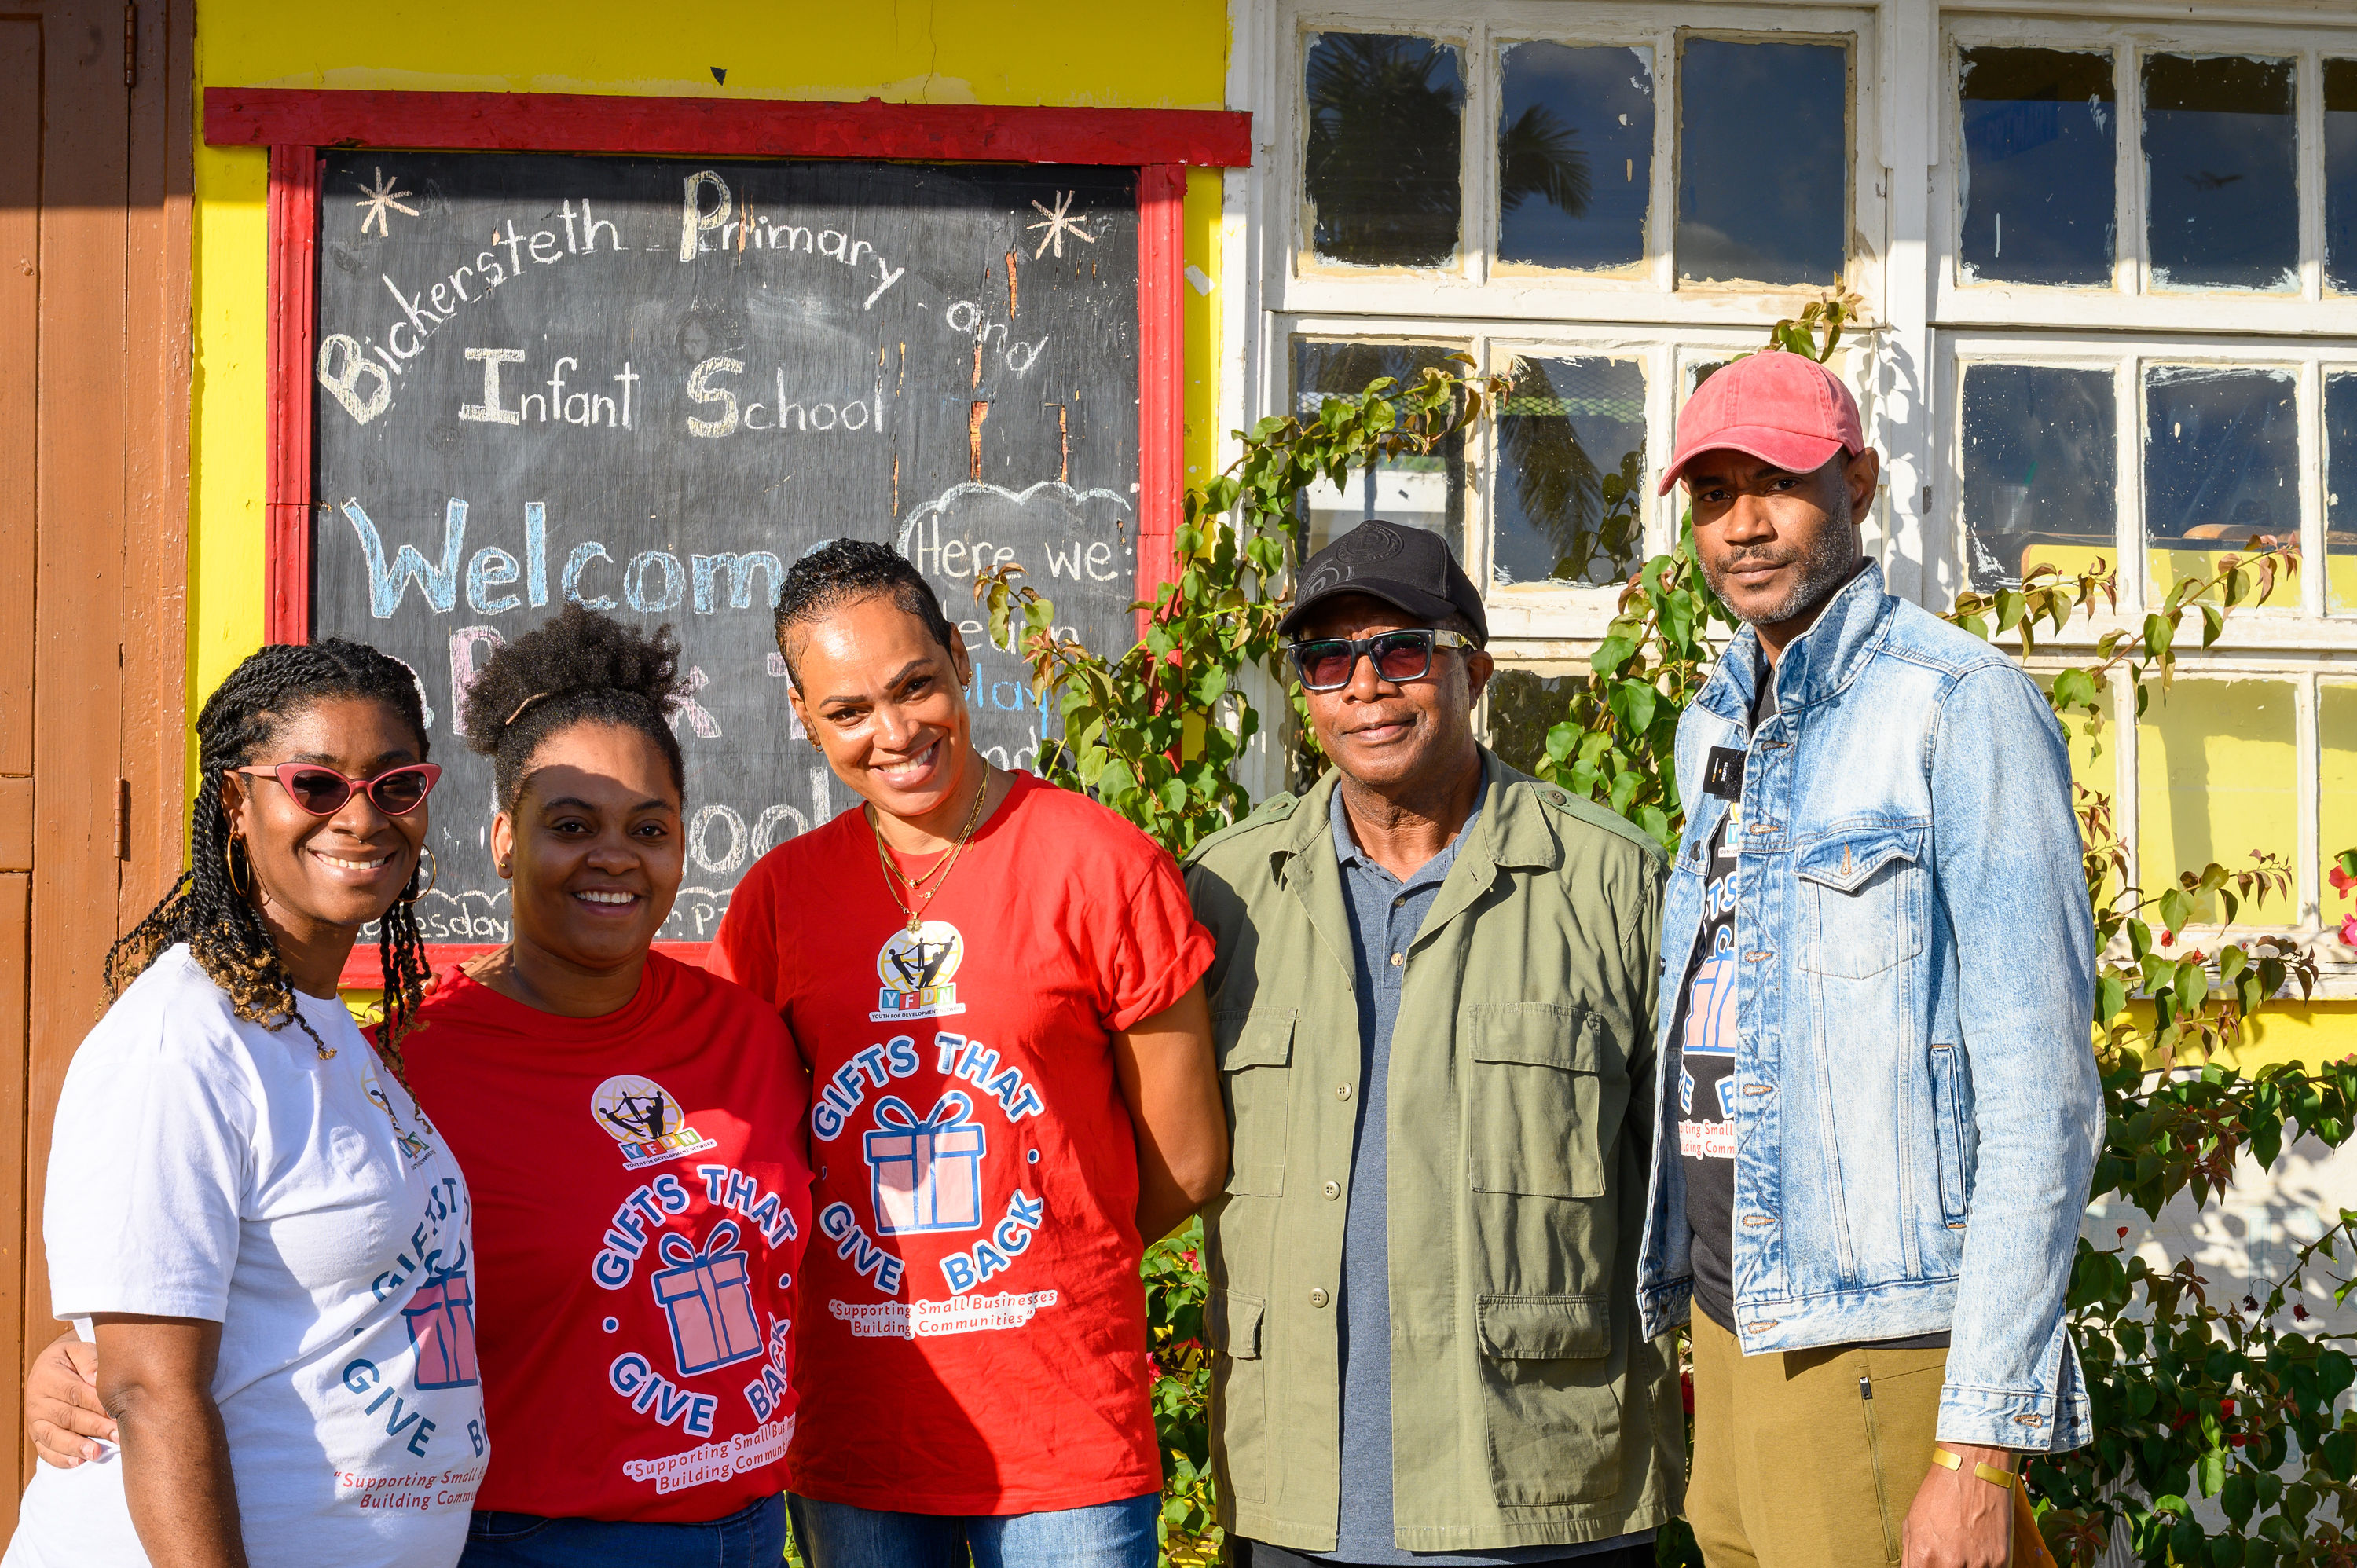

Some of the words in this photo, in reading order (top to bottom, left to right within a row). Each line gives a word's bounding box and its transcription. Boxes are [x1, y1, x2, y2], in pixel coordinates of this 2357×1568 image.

[317, 197, 621, 426] Bickersteth
[680, 169, 905, 311] Primary
[459, 347, 640, 430] Infant
[687, 357, 883, 438] School
[340, 497, 838, 619] Welcom
[917, 512, 1022, 580] Here
[966, 662, 1048, 739] lay
[885, 987, 951, 1009] YFDN
[902, 1009, 939, 1018] DEVELOPMENT
[814, 1039, 917, 1137] GIFTS
[939, 1035, 1041, 1120] THAT
[1705, 1122, 1733, 1136] Small
[625, 1131, 697, 1158] YFDN
[654, 1149, 689, 1163] DEVELOPMENT
[690, 1141, 714, 1152] NETWORK
[596, 1177, 686, 1285] GIFTS
[701, 1167, 797, 1245] THAT
[824, 1204, 903, 1291] GIVE
[944, 1192, 1043, 1291] BACK
[918, 1296, 965, 1315] Small
[973, 1292, 1054, 1310] Businesses
[853, 1321, 911, 1335] Building
[613, 1356, 714, 1433] GIVE
[747, 1316, 788, 1420] BACK
[343, 1358, 436, 1458] GIVE
[735, 1429, 769, 1450] Small
[441, 1467, 476, 1484] Small
[660, 1464, 729, 1491] Building
[360, 1493, 431, 1510] Building
